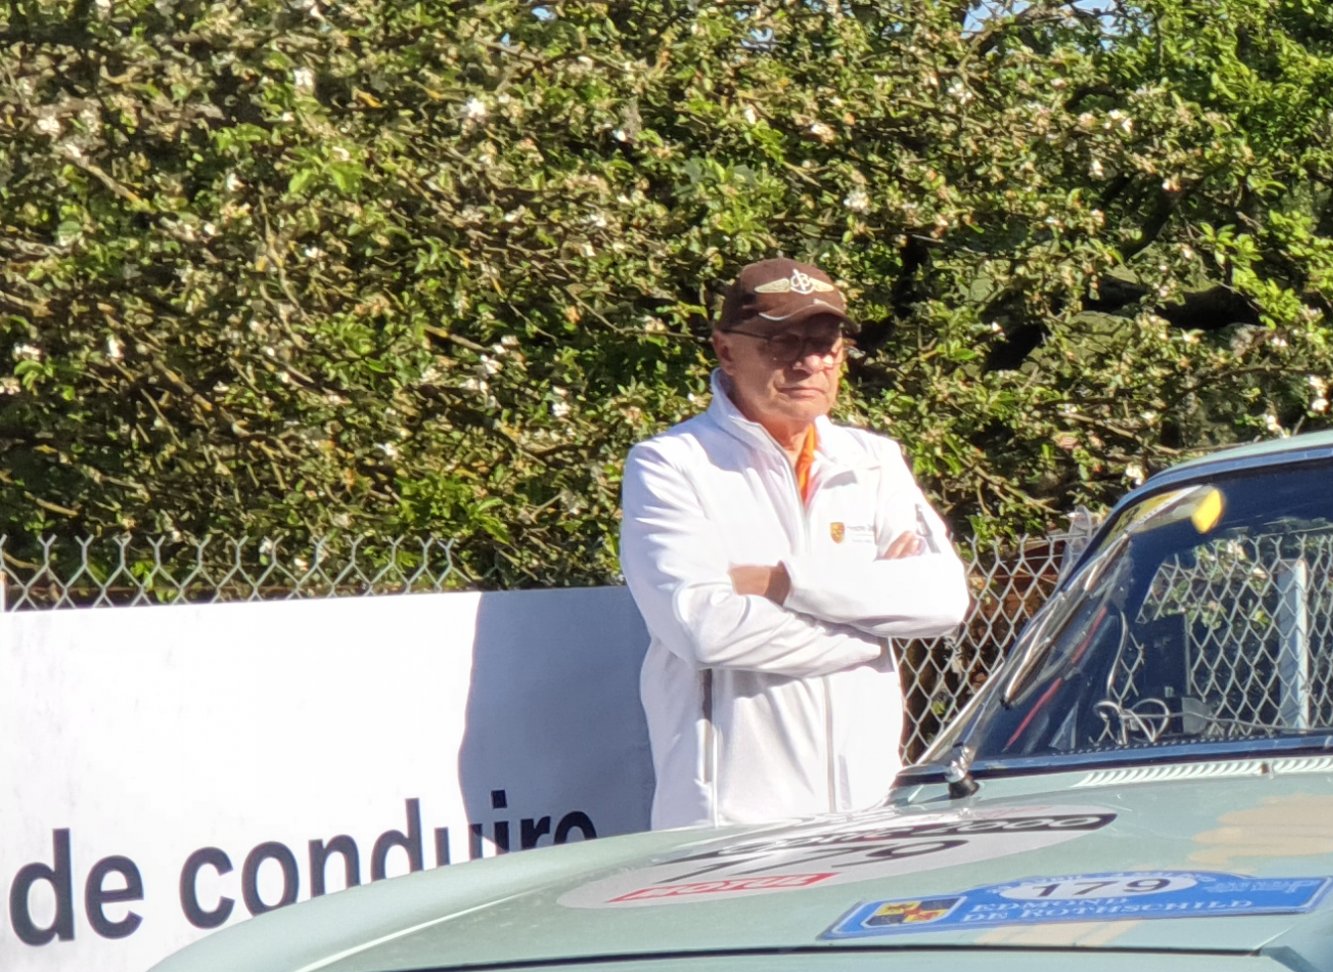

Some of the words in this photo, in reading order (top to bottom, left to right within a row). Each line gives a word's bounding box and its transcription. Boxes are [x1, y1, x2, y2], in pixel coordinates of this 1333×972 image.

[10, 827, 144, 947] de
[1031, 878, 1171, 898] 179
[961, 911, 1009, 923] DE
[1020, 900, 1253, 919] ROTHSCHILD
[969, 898, 1129, 913] EDMOND
